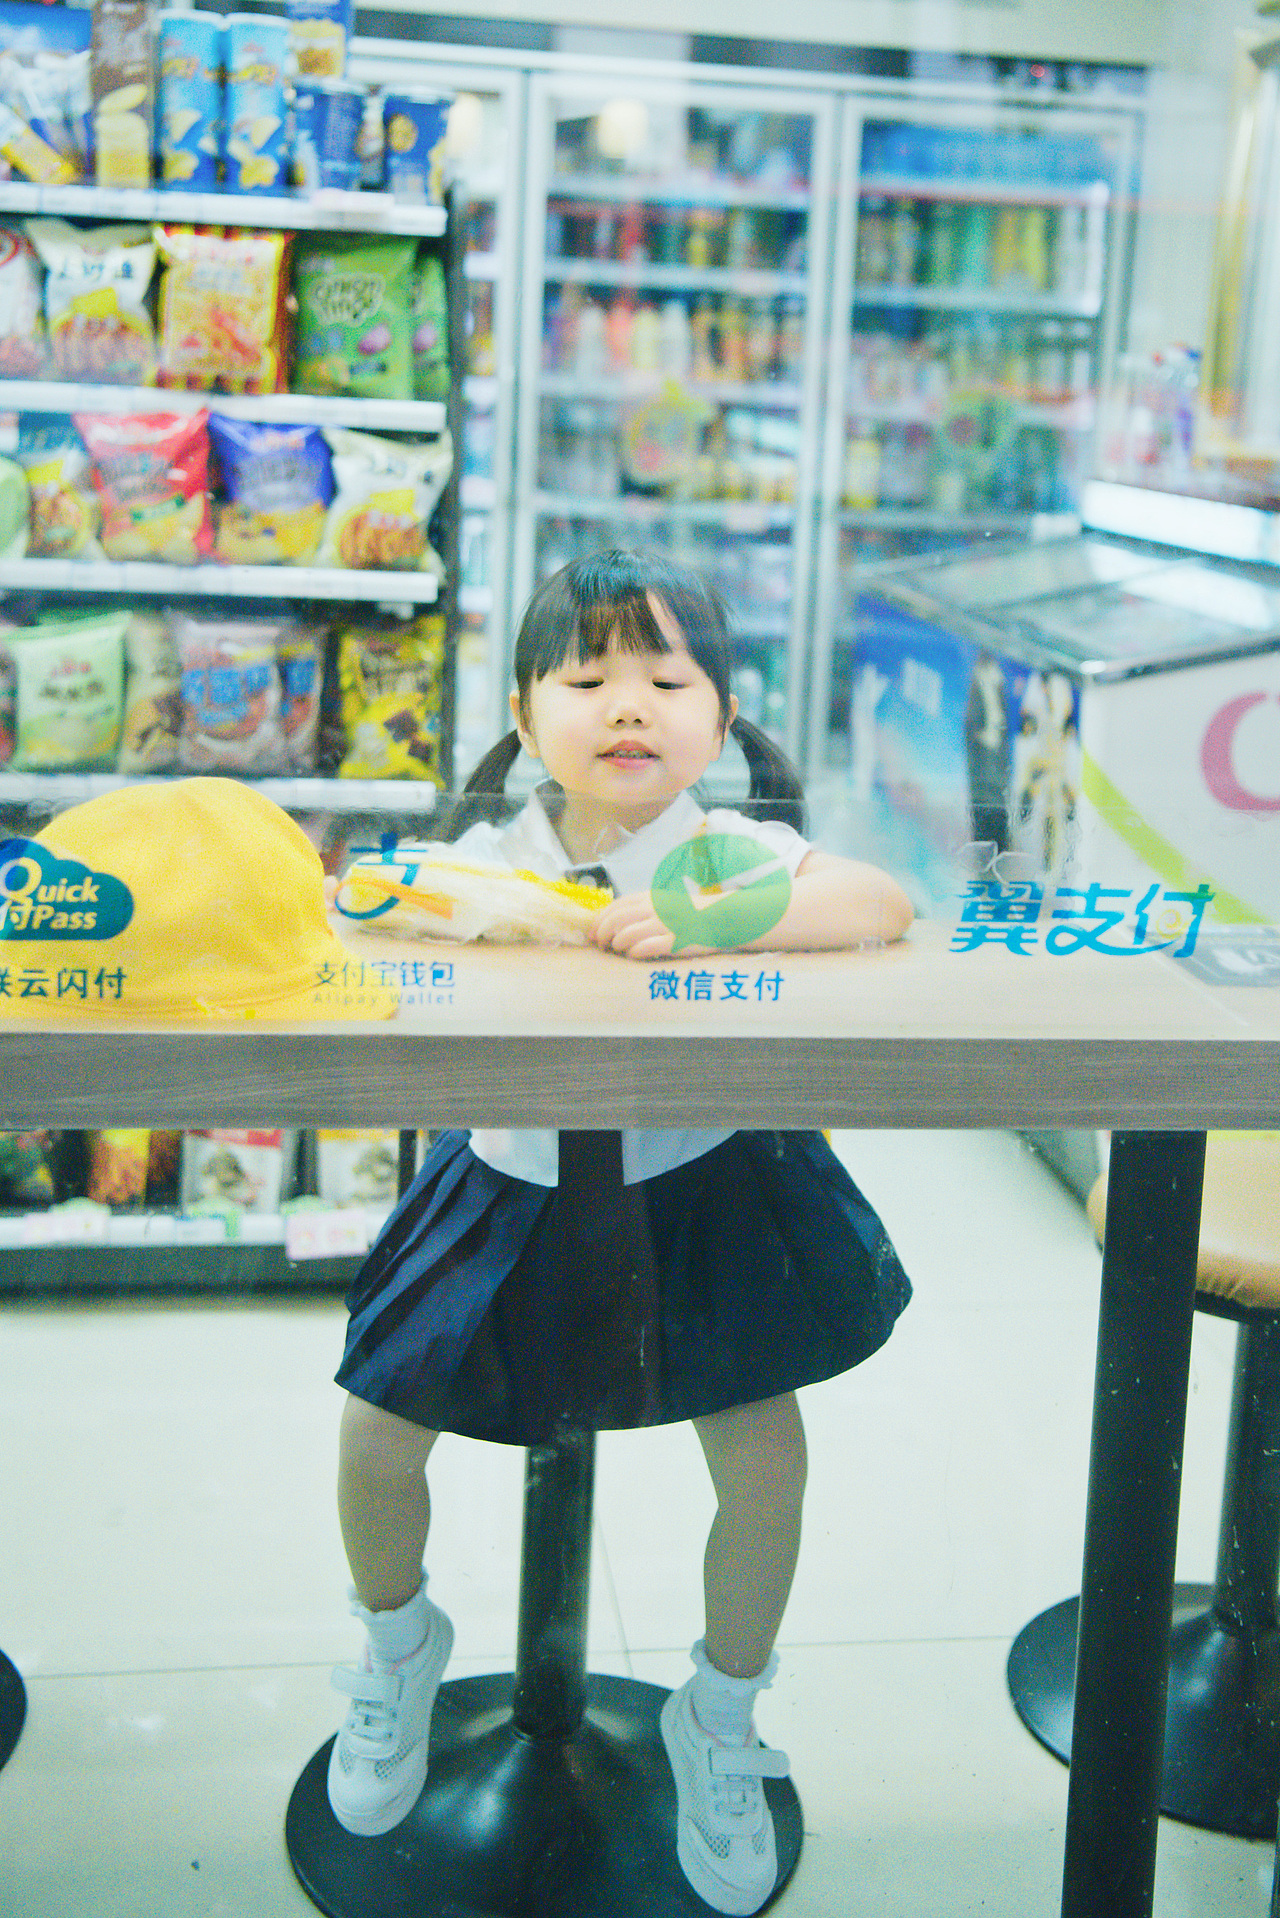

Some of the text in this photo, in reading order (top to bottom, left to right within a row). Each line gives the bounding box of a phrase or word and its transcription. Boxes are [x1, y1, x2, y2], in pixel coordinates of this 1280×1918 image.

[0, 857, 100, 903] Quick
[32, 904, 98, 930] Pass
[948, 880, 1216, 958] 翼支付
[314, 961, 455, 988] 支付宝钱包
[648, 970, 785, 1001] 微信支付
[313, 992, 455, 1006] Alipay Wallet
